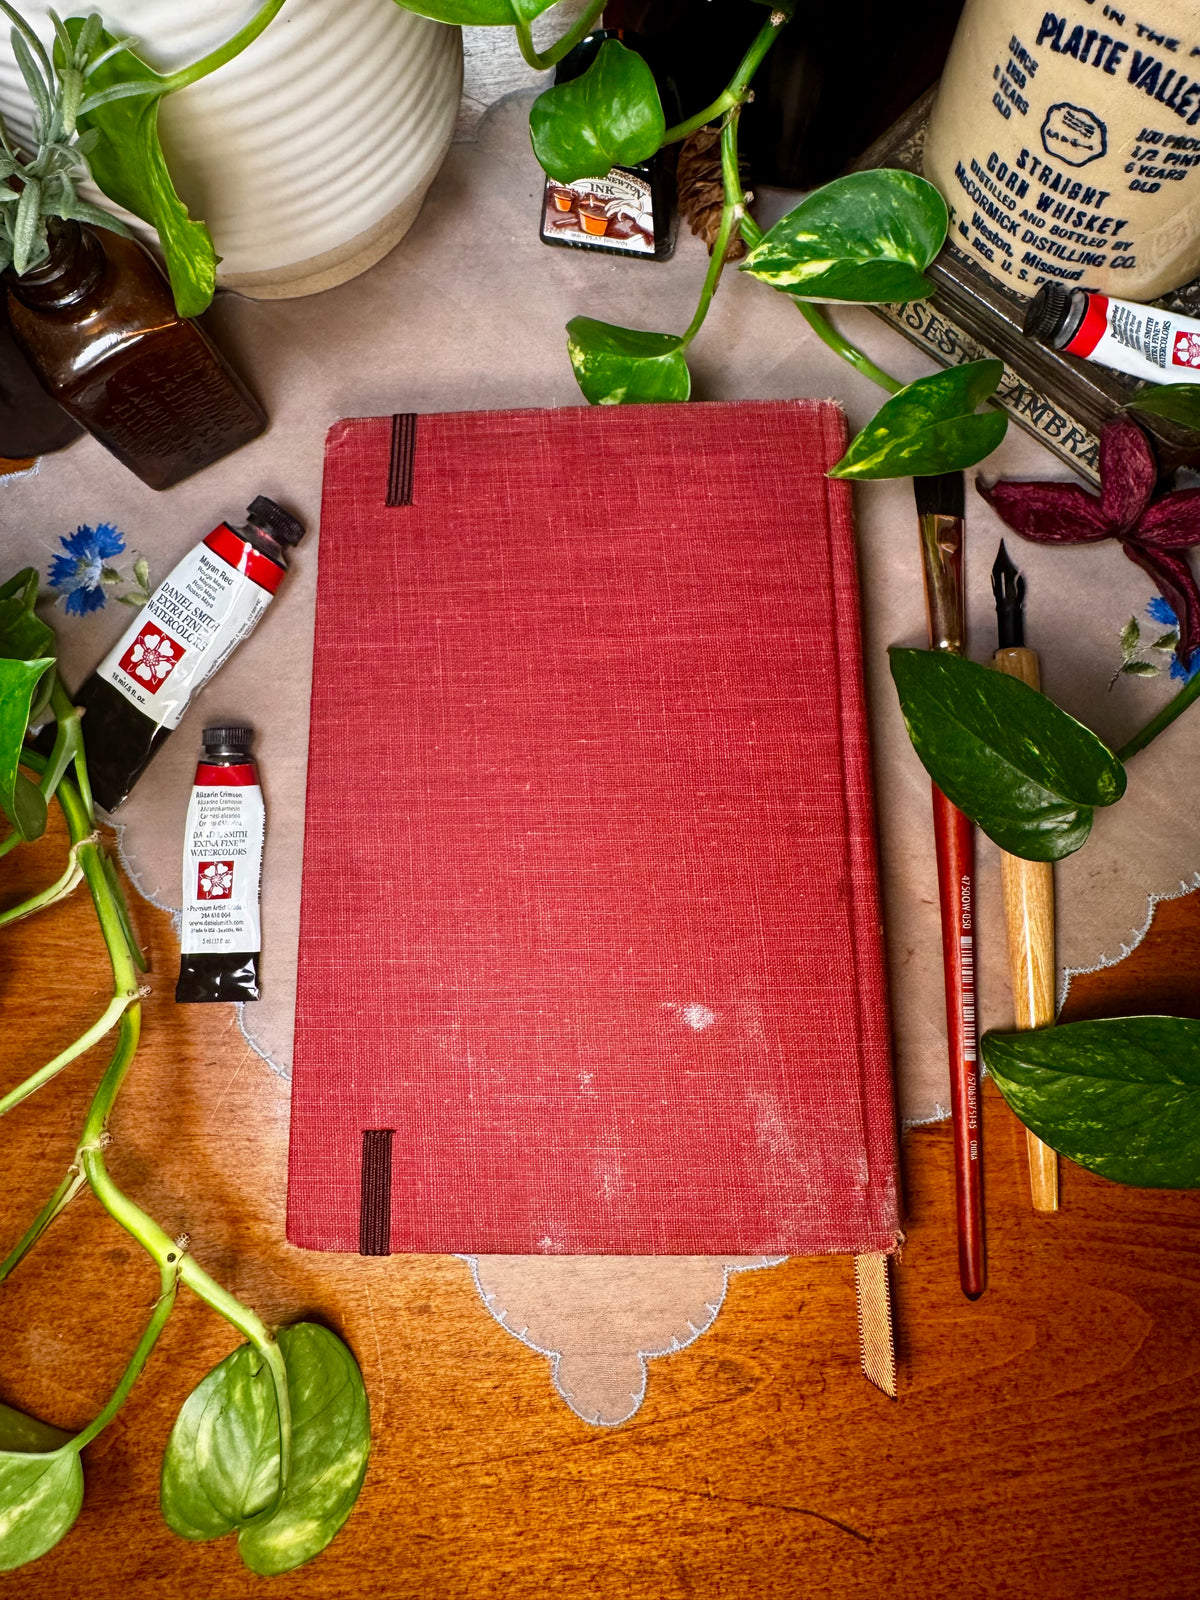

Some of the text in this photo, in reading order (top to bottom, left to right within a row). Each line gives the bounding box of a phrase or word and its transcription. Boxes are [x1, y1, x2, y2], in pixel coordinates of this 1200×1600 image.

[1035, 12, 1129, 76] PLATTE
[1134, 22, 1181, 53] THE
[1008, 34, 1039, 78] SINCE
[992, 91, 1011, 120] OLD
[1000, 73, 1029, 116] YEARS
[1015, 148, 1110, 209] STRAIGHT
[1128, 179, 1161, 193] OLD
[1138, 164, 1188, 181] YEARS
[590, 183, 615, 195] INK
[986, 151, 1129, 237] CORN WHISKEY
[954, 160, 1021, 238] McCORMICK
[1021, 229, 1107, 268] DISTILLING
[970, 158, 1135, 252] DISTILLED AND BOTTLED BY
[972, 211, 1014, 258] Weston,
[972, 237, 995, 263] REG.
[1000, 259, 1013, 275] U.
[1017, 268, 1028, 281] S.
[1144, 316, 1154, 340] SMITH
[1159, 320, 1172, 368] WATERCOLORS
[197, 566, 226, 591] Rouge Maya
[199, 555, 234, 586] Mayan Red
[160, 582, 194, 616] DANIEL
[191, 579, 216, 602] Rojo Maya
[200, 594, 214, 609] Maya
[155, 593, 184, 623] EXTRA
[147, 600, 209, 652] WATERCOLORS
[190, 847, 247, 857] WATERCOLORS
[969, 1140, 978, 1161] CHINA
